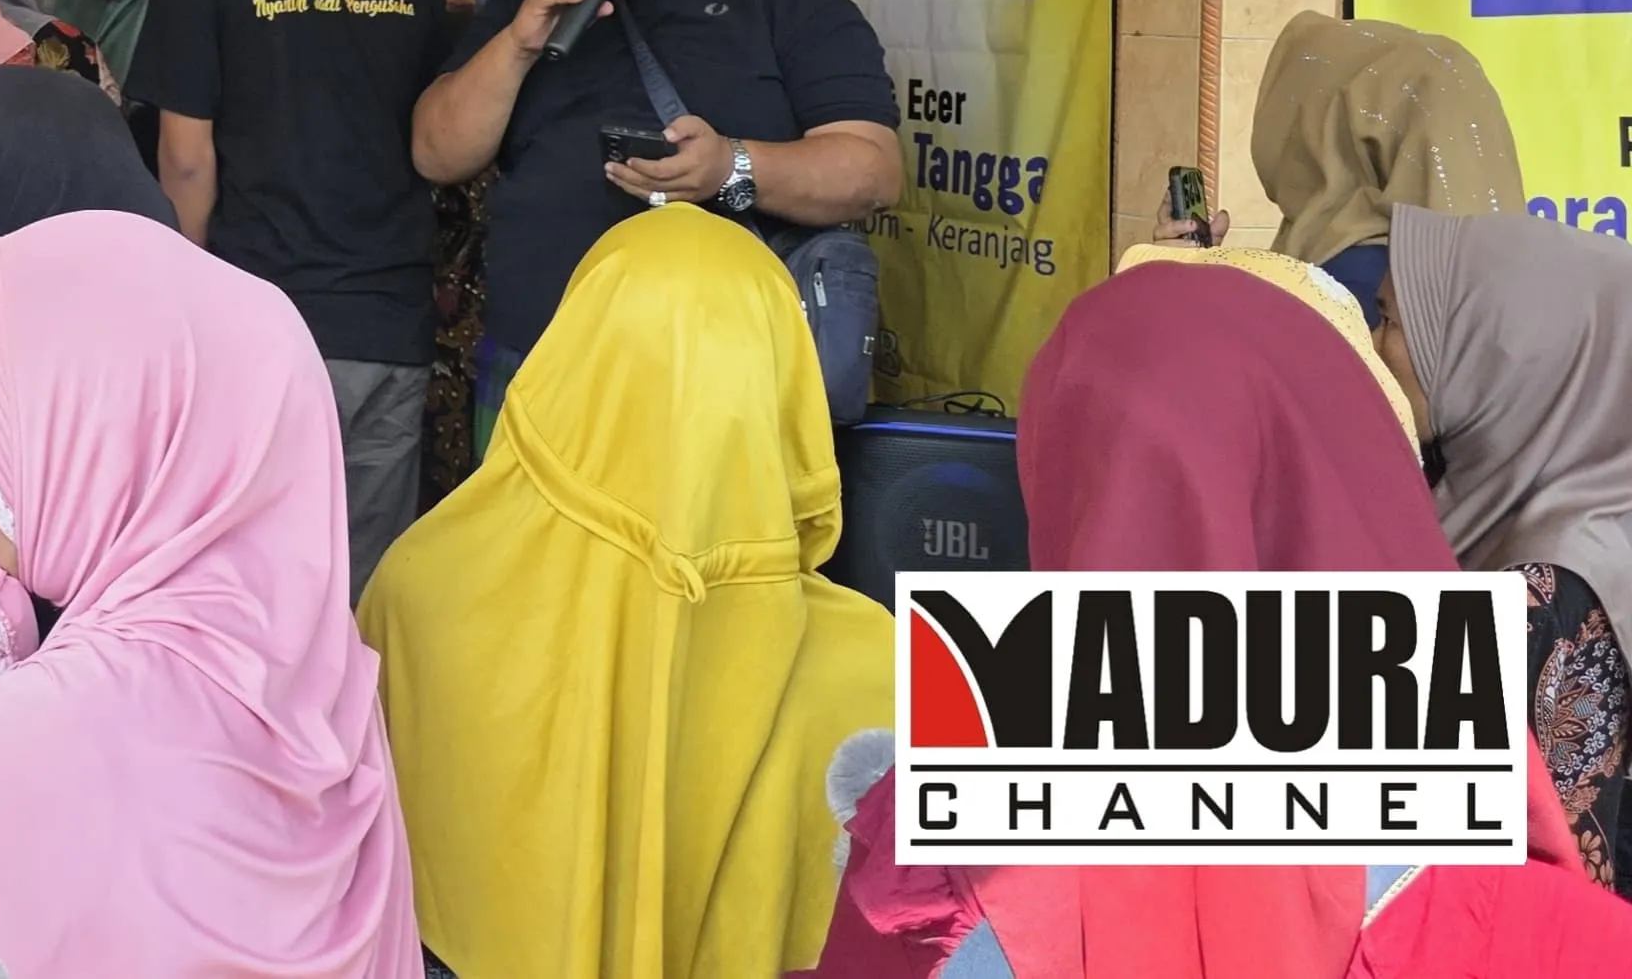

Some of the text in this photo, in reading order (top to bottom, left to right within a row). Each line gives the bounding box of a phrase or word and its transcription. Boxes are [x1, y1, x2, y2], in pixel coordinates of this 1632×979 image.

[907, 78, 966, 126] Ecer
[913, 132, 1049, 215] Tangga
[922, 518, 989, 560] JBL
